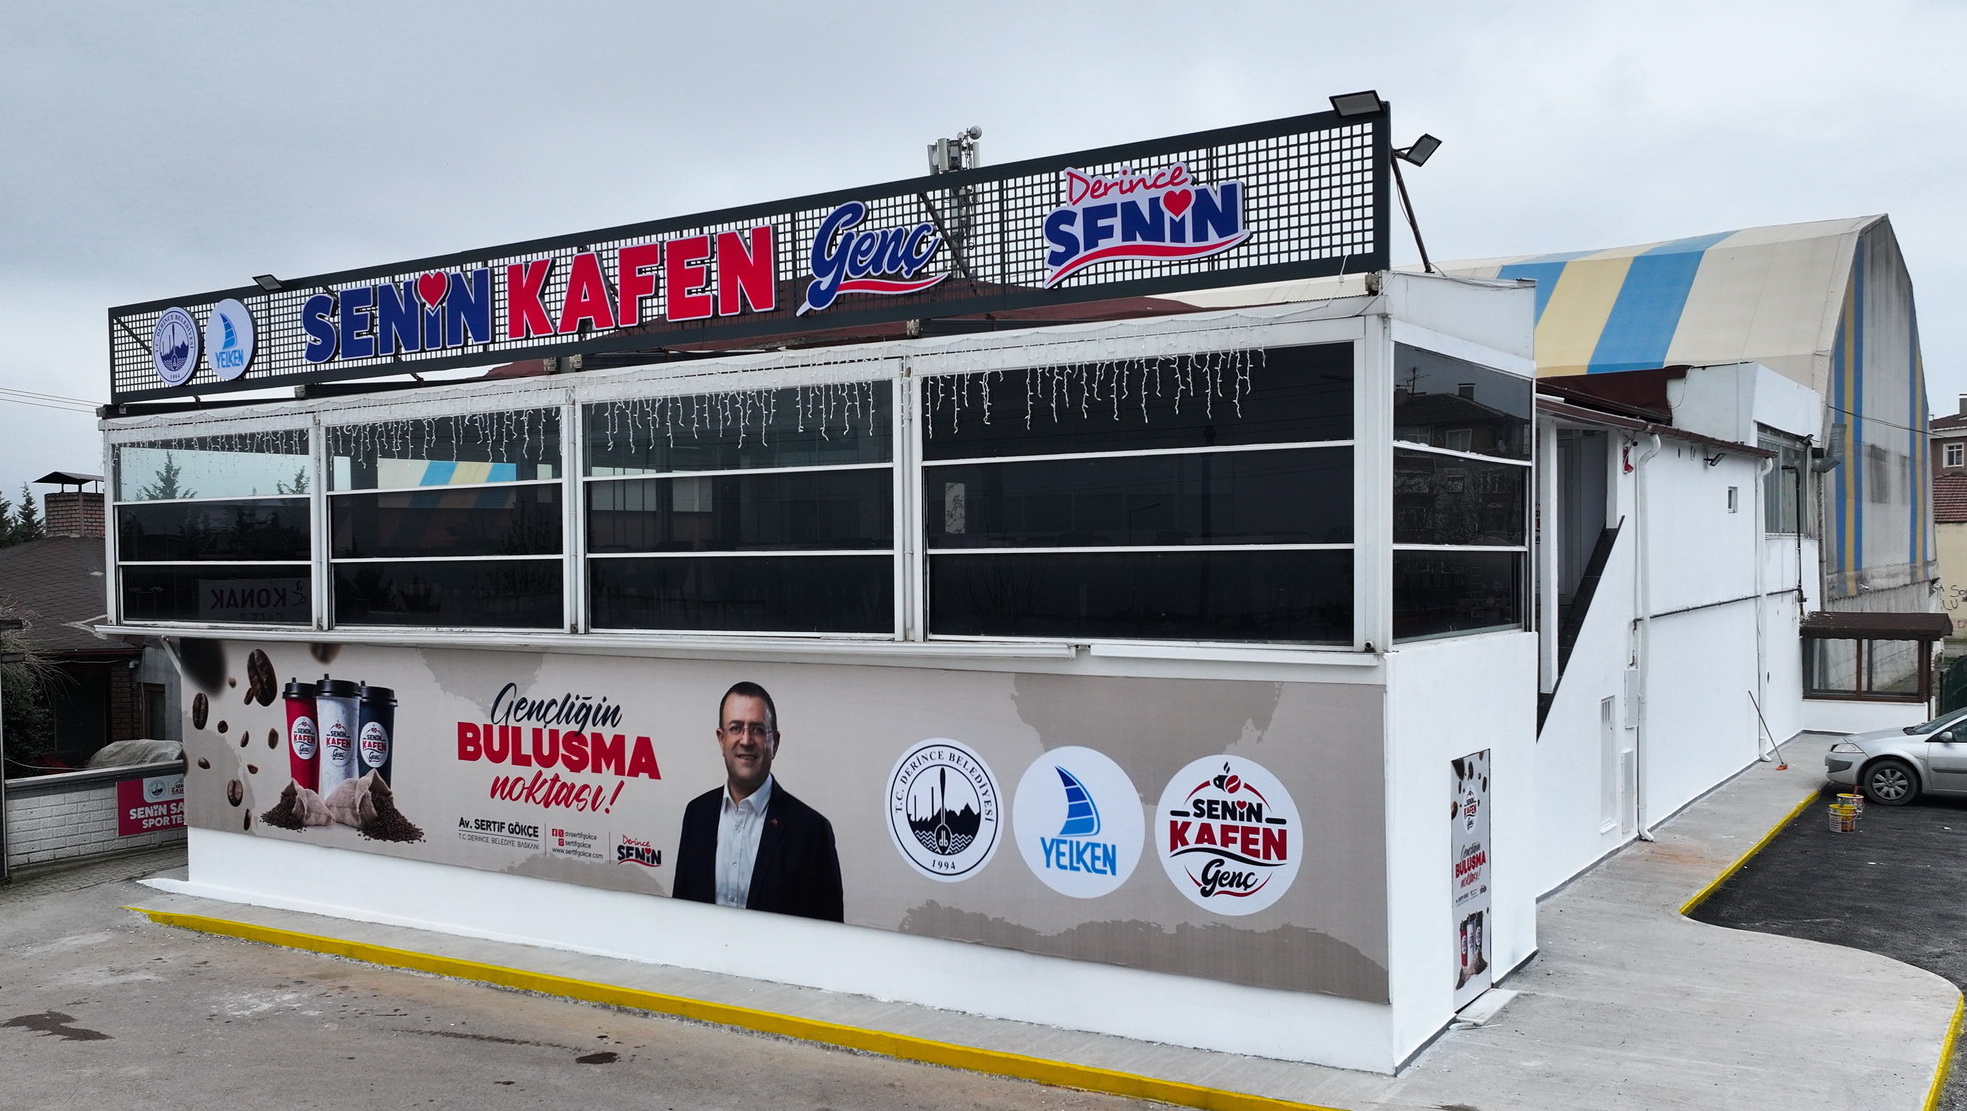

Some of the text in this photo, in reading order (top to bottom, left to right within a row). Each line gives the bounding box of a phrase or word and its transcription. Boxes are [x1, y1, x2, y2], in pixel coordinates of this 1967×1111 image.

[1066, 166, 1188, 206] Derince
[506, 224, 775, 340] KAFEN
[806, 201, 941, 310] Genç
[215, 349, 244, 369] YELKEN
[491, 682, 622, 736] Gençliğin
[293, 734, 315, 744] KAFEN
[325, 737, 351, 748] KAFEN
[362, 741, 386, 751] KAFEN
[490, 769, 625, 814] noktası!
[900, 750, 944, 785] DERİNCE
[949, 752, 995, 822] BELEDİYESİ
[142, 814, 184, 829] SPOR TE
[459, 817, 472, 829] Av.
[508, 821, 539, 838] GÖKÇE
[622, 834, 651, 848] Derince
[1169, 820, 1287, 861] KAFEN
[932, 859, 956, 870] 1994
[1040, 837, 1116, 876] YELKEN
[1200, 858, 1258, 898] Genç
